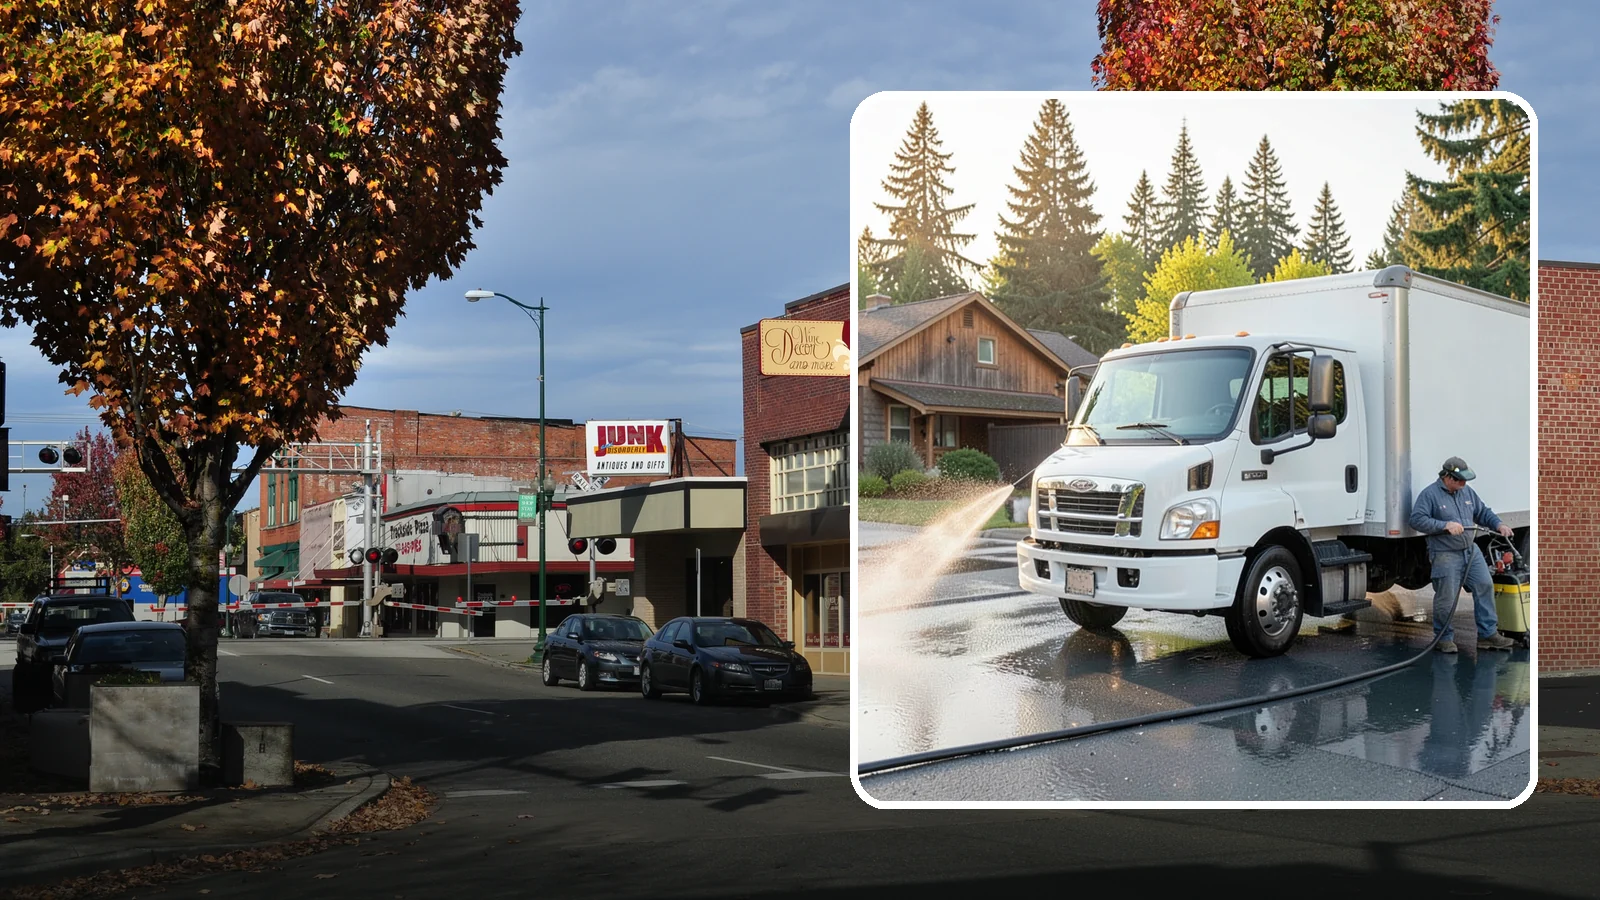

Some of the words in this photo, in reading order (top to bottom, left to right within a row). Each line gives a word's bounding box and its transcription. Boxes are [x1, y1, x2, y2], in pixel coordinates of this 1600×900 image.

[595, 425, 666, 457] JUNK
[607, 446, 645, 454] DISORDERLY
[597, 461, 628, 470] ANTIQUES
[631, 461, 644, 470] AND
[647, 460, 665, 469] GIFTS
[390, 521, 413, 540] Trackside
[414, 519, 429, 535] Pizza
